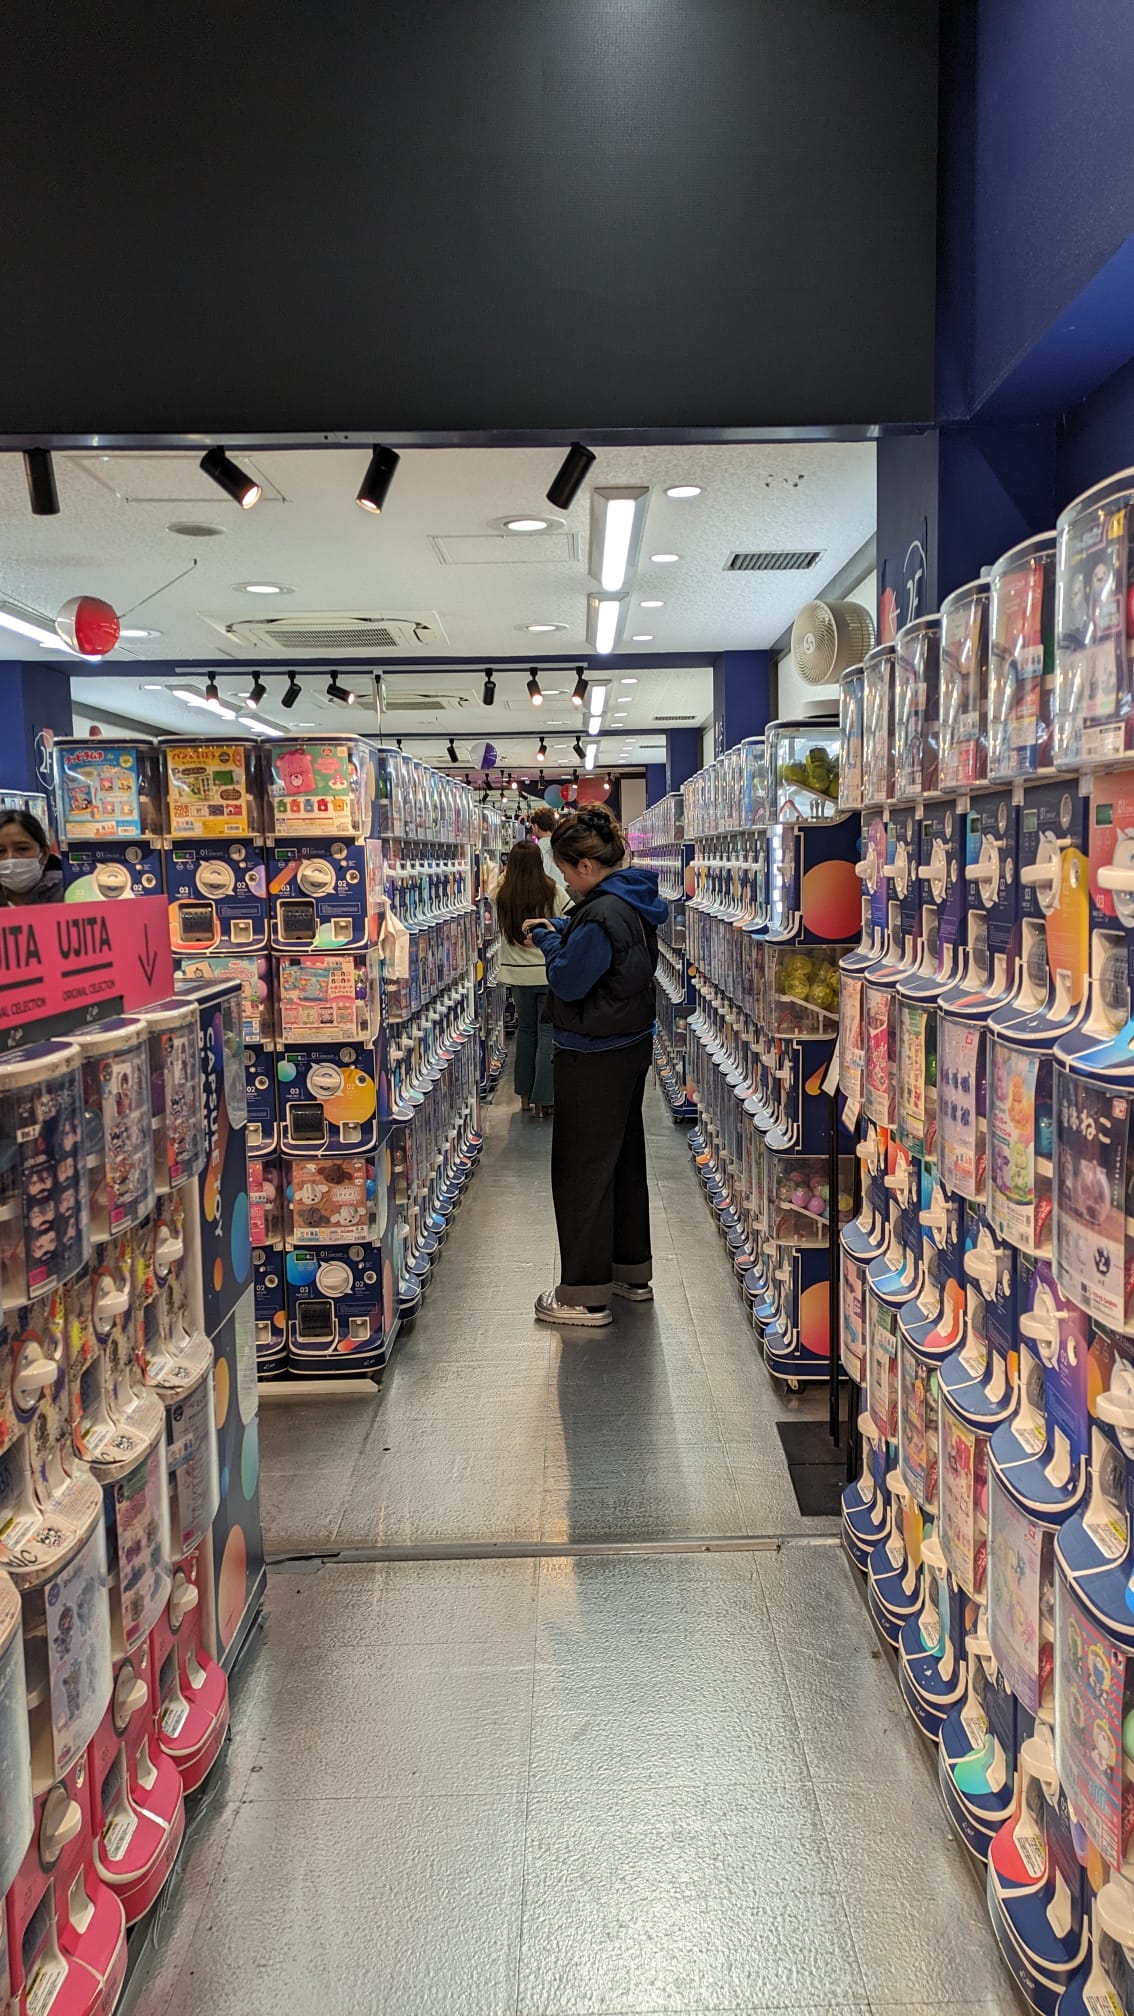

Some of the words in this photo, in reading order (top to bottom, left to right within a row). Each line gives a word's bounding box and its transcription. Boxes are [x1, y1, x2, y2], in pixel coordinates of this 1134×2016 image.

[57, 916, 112, 960] UJITA
[63, 986, 89, 1001] ORIGINAL
[206, 1026, 220, 1167] CAPSULE
[213, 1174, 223, 1238] TOY
